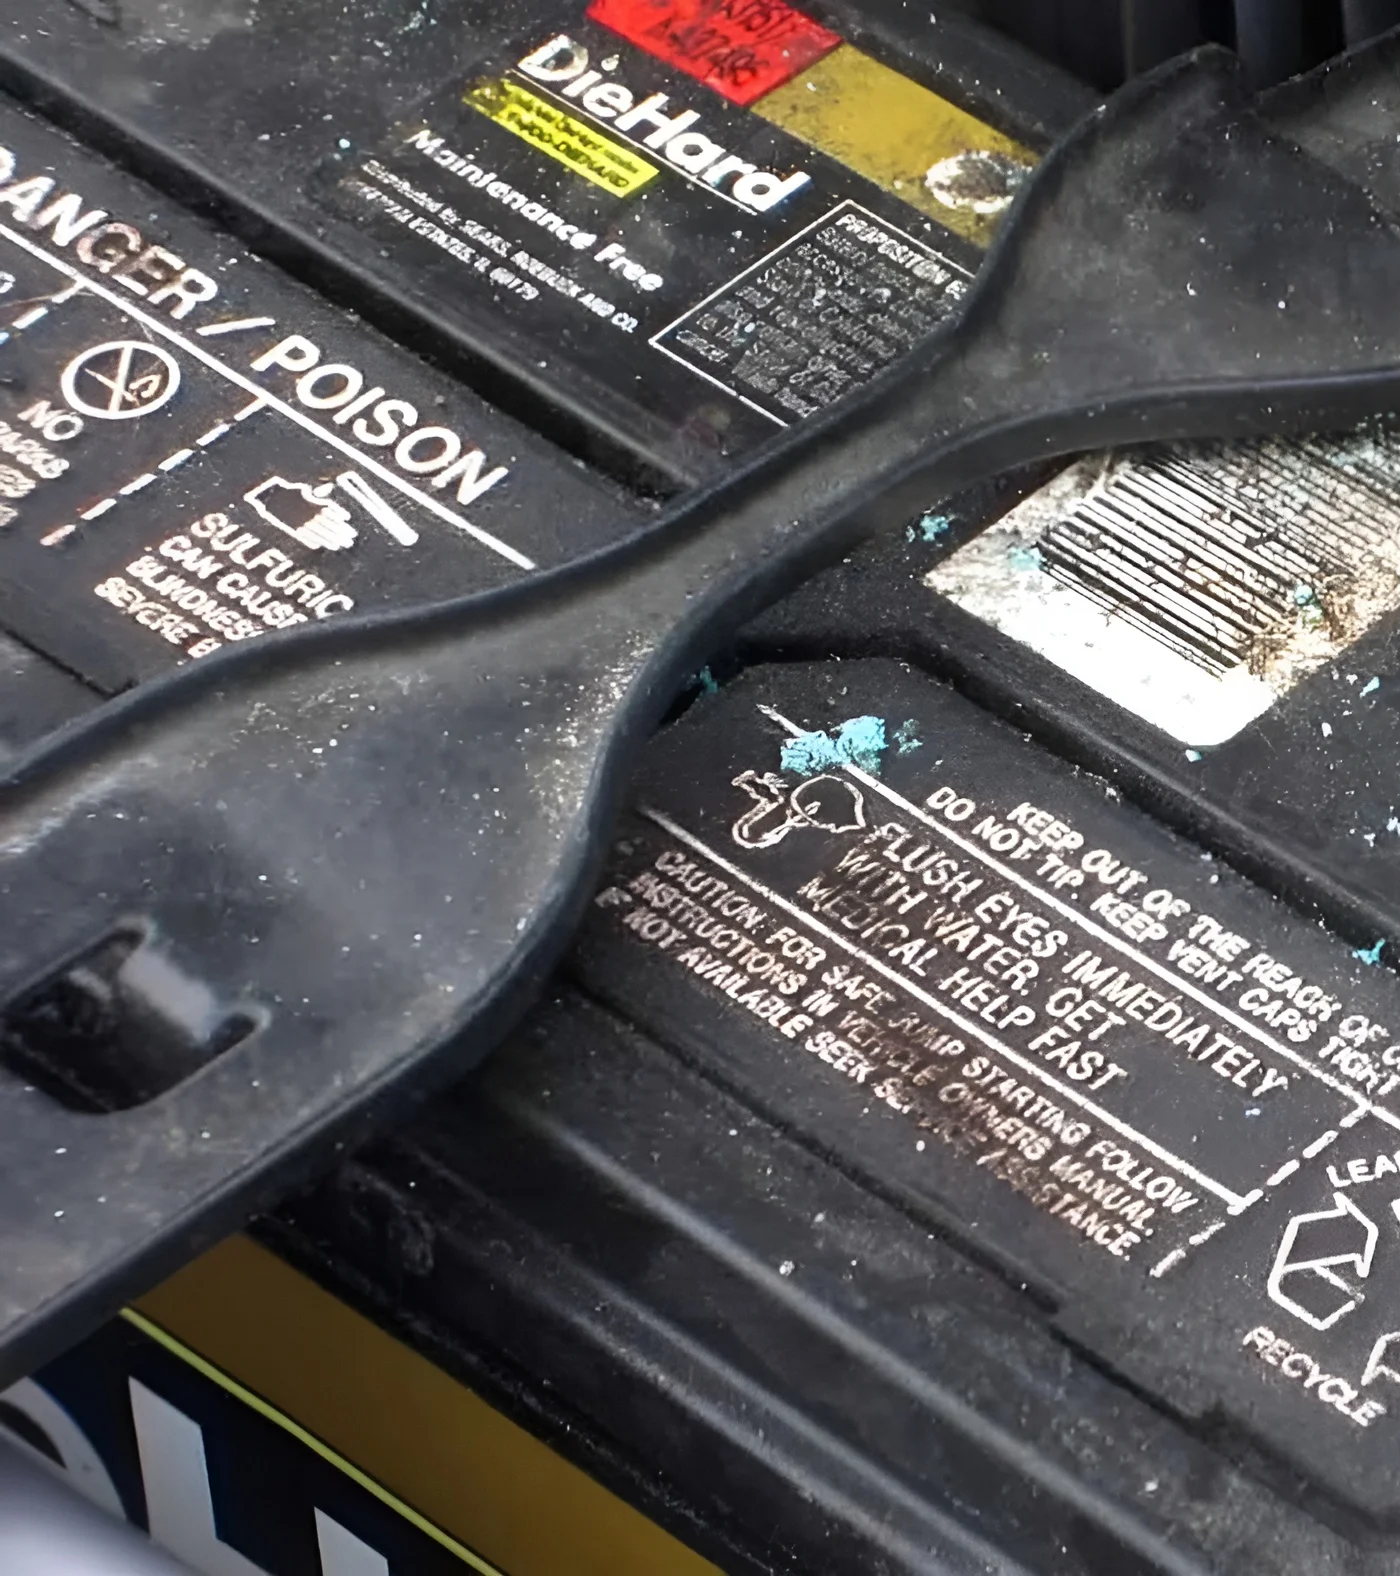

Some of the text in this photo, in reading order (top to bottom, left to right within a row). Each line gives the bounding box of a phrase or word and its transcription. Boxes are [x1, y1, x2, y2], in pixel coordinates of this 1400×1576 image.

[403, 130, 665, 291] Maintenance Free
[517, 33, 812, 213] DieHard
[577, 292, 617, 319] AND
[834, 213, 952, 286] PROPOSITION
[17, 400, 84, 441] NO
[250, 334, 510, 506] POISON
[159, 535, 224, 580] CAN
[190, 512, 354, 619] SULFURIC
[622, 904, 688, 950] NOT
[676, 945, 815, 1040] AVAILABLE
[804, 1031, 877, 1085] SEEK
[629, 871, 809, 996] INSTRUCTIONS
[801, 988, 842, 1017] IN
[837, 1009, 950, 1087] VEHCLE
[796, 872, 1130, 1092] MEDICAL HELP FAST
[835, 846, 930, 916] WITH
[1045, 986, 1128, 1042] GET
[876, 821, 1290, 1098] FLUSH EYES IMMEDIATELY
[925, 786, 976, 822] DO
[971, 814, 1041, 861] NOT
[1035, 852, 1086, 901] TIP.
[1089, 892, 1169, 943] KEEP
[1166, 938, 1245, 992] VENT
[1238, 987, 1318, 1043] CAPS
[1006, 801, 1085, 852] KEEP
[1081, 849, 1148, 894] OUT
[1142, 888, 1191, 920] OF
[1188, 914, 1251, 963] THE
[1241, 953, 1343, 1022] REACH
[1339, 1014, 1391, 1049] OF
[764, 926, 829, 972] FOR
[820, 964, 898, 1015] SAFE
[961, 1056, 1092, 1146] STARTING
[1084, 1139, 1200, 1214] FOLLOW
[1241, 1326, 1389, 1428] RECYCLE
